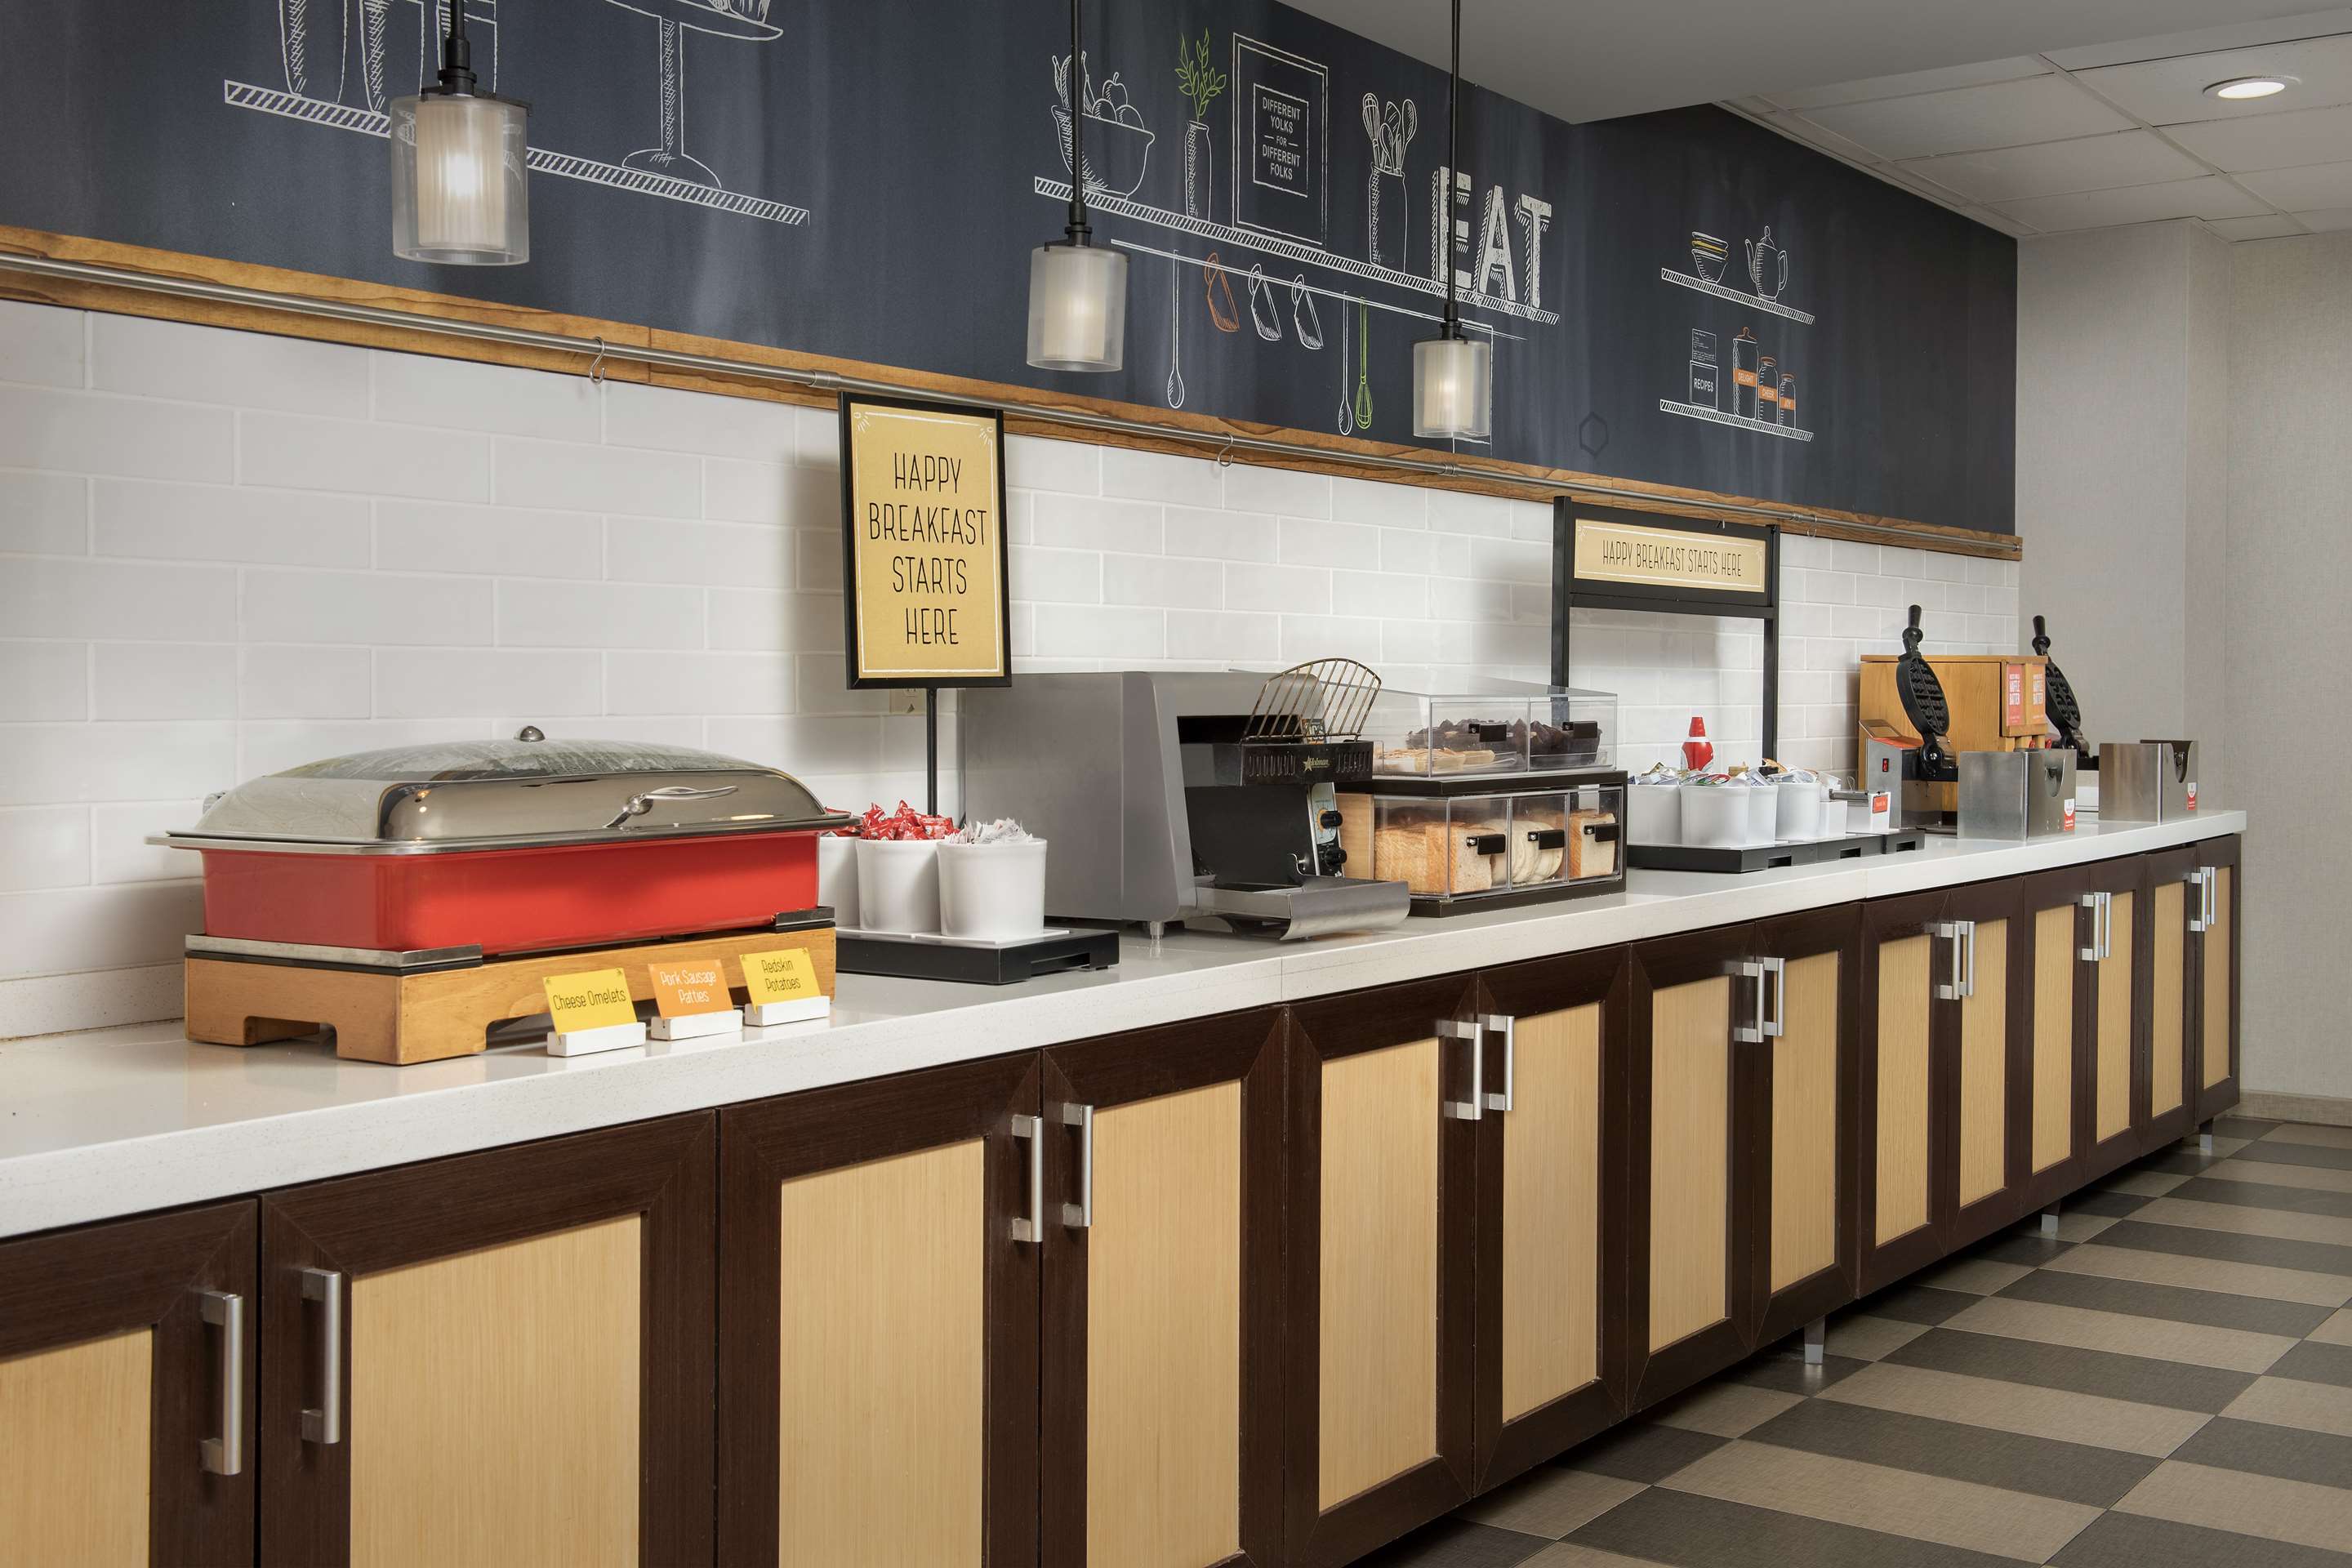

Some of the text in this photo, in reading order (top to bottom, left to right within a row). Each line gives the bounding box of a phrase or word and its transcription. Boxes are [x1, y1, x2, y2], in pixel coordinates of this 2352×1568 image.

[1263, 96, 1301, 121] DIFFERENT
[1270, 115, 1294, 134] YOLKS
[1276, 136, 1287, 146] FOR
[1263, 144, 1301, 167] DIFFERENT
[1270, 163, 1294, 180] FOLKS
[1432, 166, 1552, 309] EAT
[1694, 377, 1714, 392] RECIPES
[894, 452, 961, 493] HAPPY
[869, 502, 987, 546] BREAKFAST
[1602, 540, 1742, 577] HAPPY BREAKFAST STARTS HERE
[893, 556, 967, 595] STARTS
[906, 608, 960, 645] HERE
[660, 969, 717, 987] Pork Sausage
[761, 959, 794, 974] Redskin
[765, 975, 801, 992] Potatoes
[553, 987, 627, 1011] Cheese Omelets
[678, 987, 710, 1004] Patties
